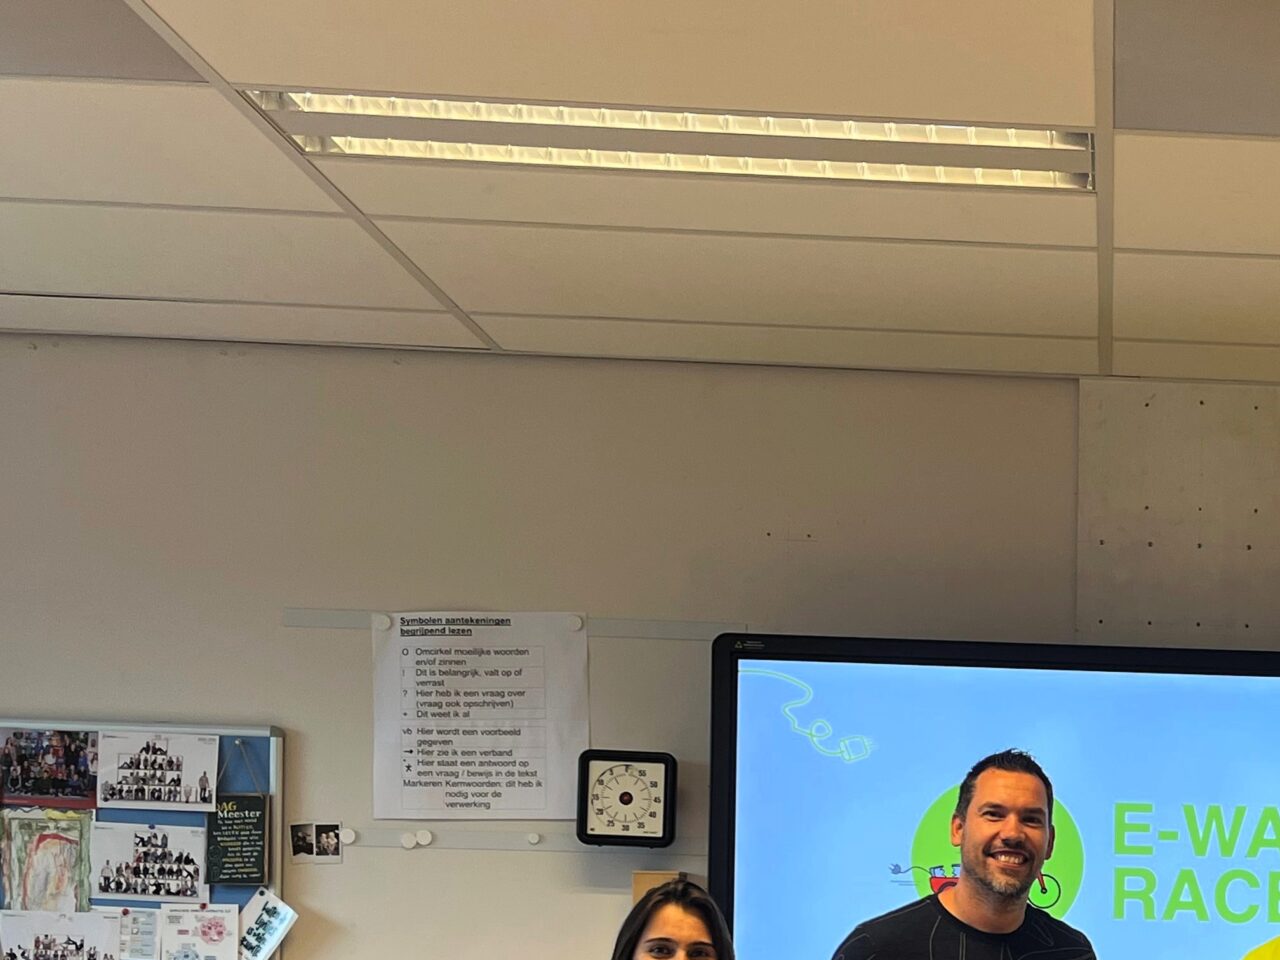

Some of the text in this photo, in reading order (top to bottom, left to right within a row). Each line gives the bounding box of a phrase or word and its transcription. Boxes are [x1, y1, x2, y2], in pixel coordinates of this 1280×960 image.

[400, 617, 511, 626] Symbolen aantekeningen
[400, 627, 473, 637] begrijpend lezen
[415, 648, 452, 656] Omcirkel
[493, 648, 529, 656] woorden
[501, 670, 512, 679] op
[481, 691, 505, 699] vraag
[436, 728, 460, 736] wordt
[481, 728, 521, 736] voorbeeld
[417, 739, 453, 747] gegeven
[479, 749, 513, 757] verband
[478, 760, 516, 768] antwoord
[519, 762, 529, 770] op
[436, 771, 459, 779] vraag
[467, 770, 493, 779] bewijs
[445, 791, 468, 799] nodig
[445, 801, 490, 809] verwerking
